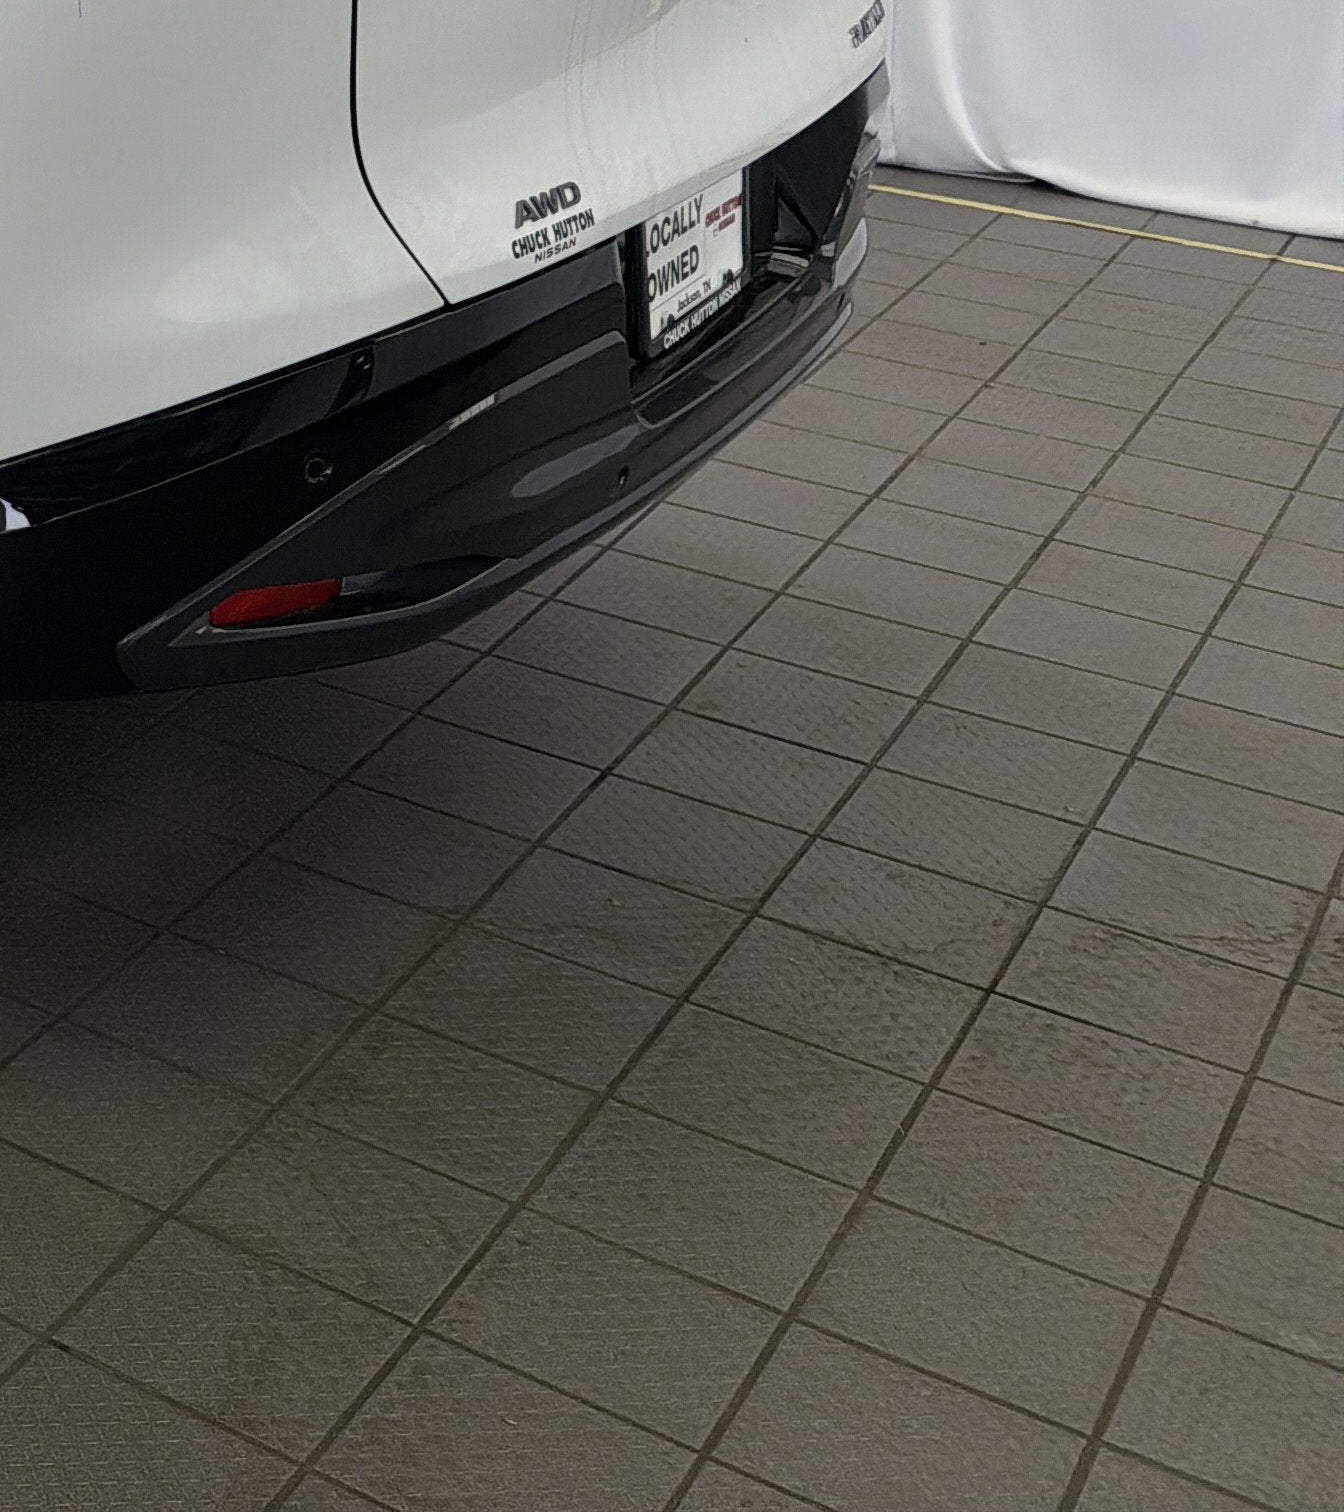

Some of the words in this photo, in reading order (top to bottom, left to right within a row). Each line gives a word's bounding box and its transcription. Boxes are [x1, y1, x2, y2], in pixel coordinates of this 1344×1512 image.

[515, 181, 581, 230] AWD
[645, 193, 703, 258] OCALLY
[511, 226, 551, 259] CHUCK
[552, 208, 595, 243] HUTTON
[534, 236, 577, 264] NISSAN
[647, 244, 699, 303] OWNED
[664, 318, 690, 349] CHUCK
[690, 296, 718, 330] HUTTON
